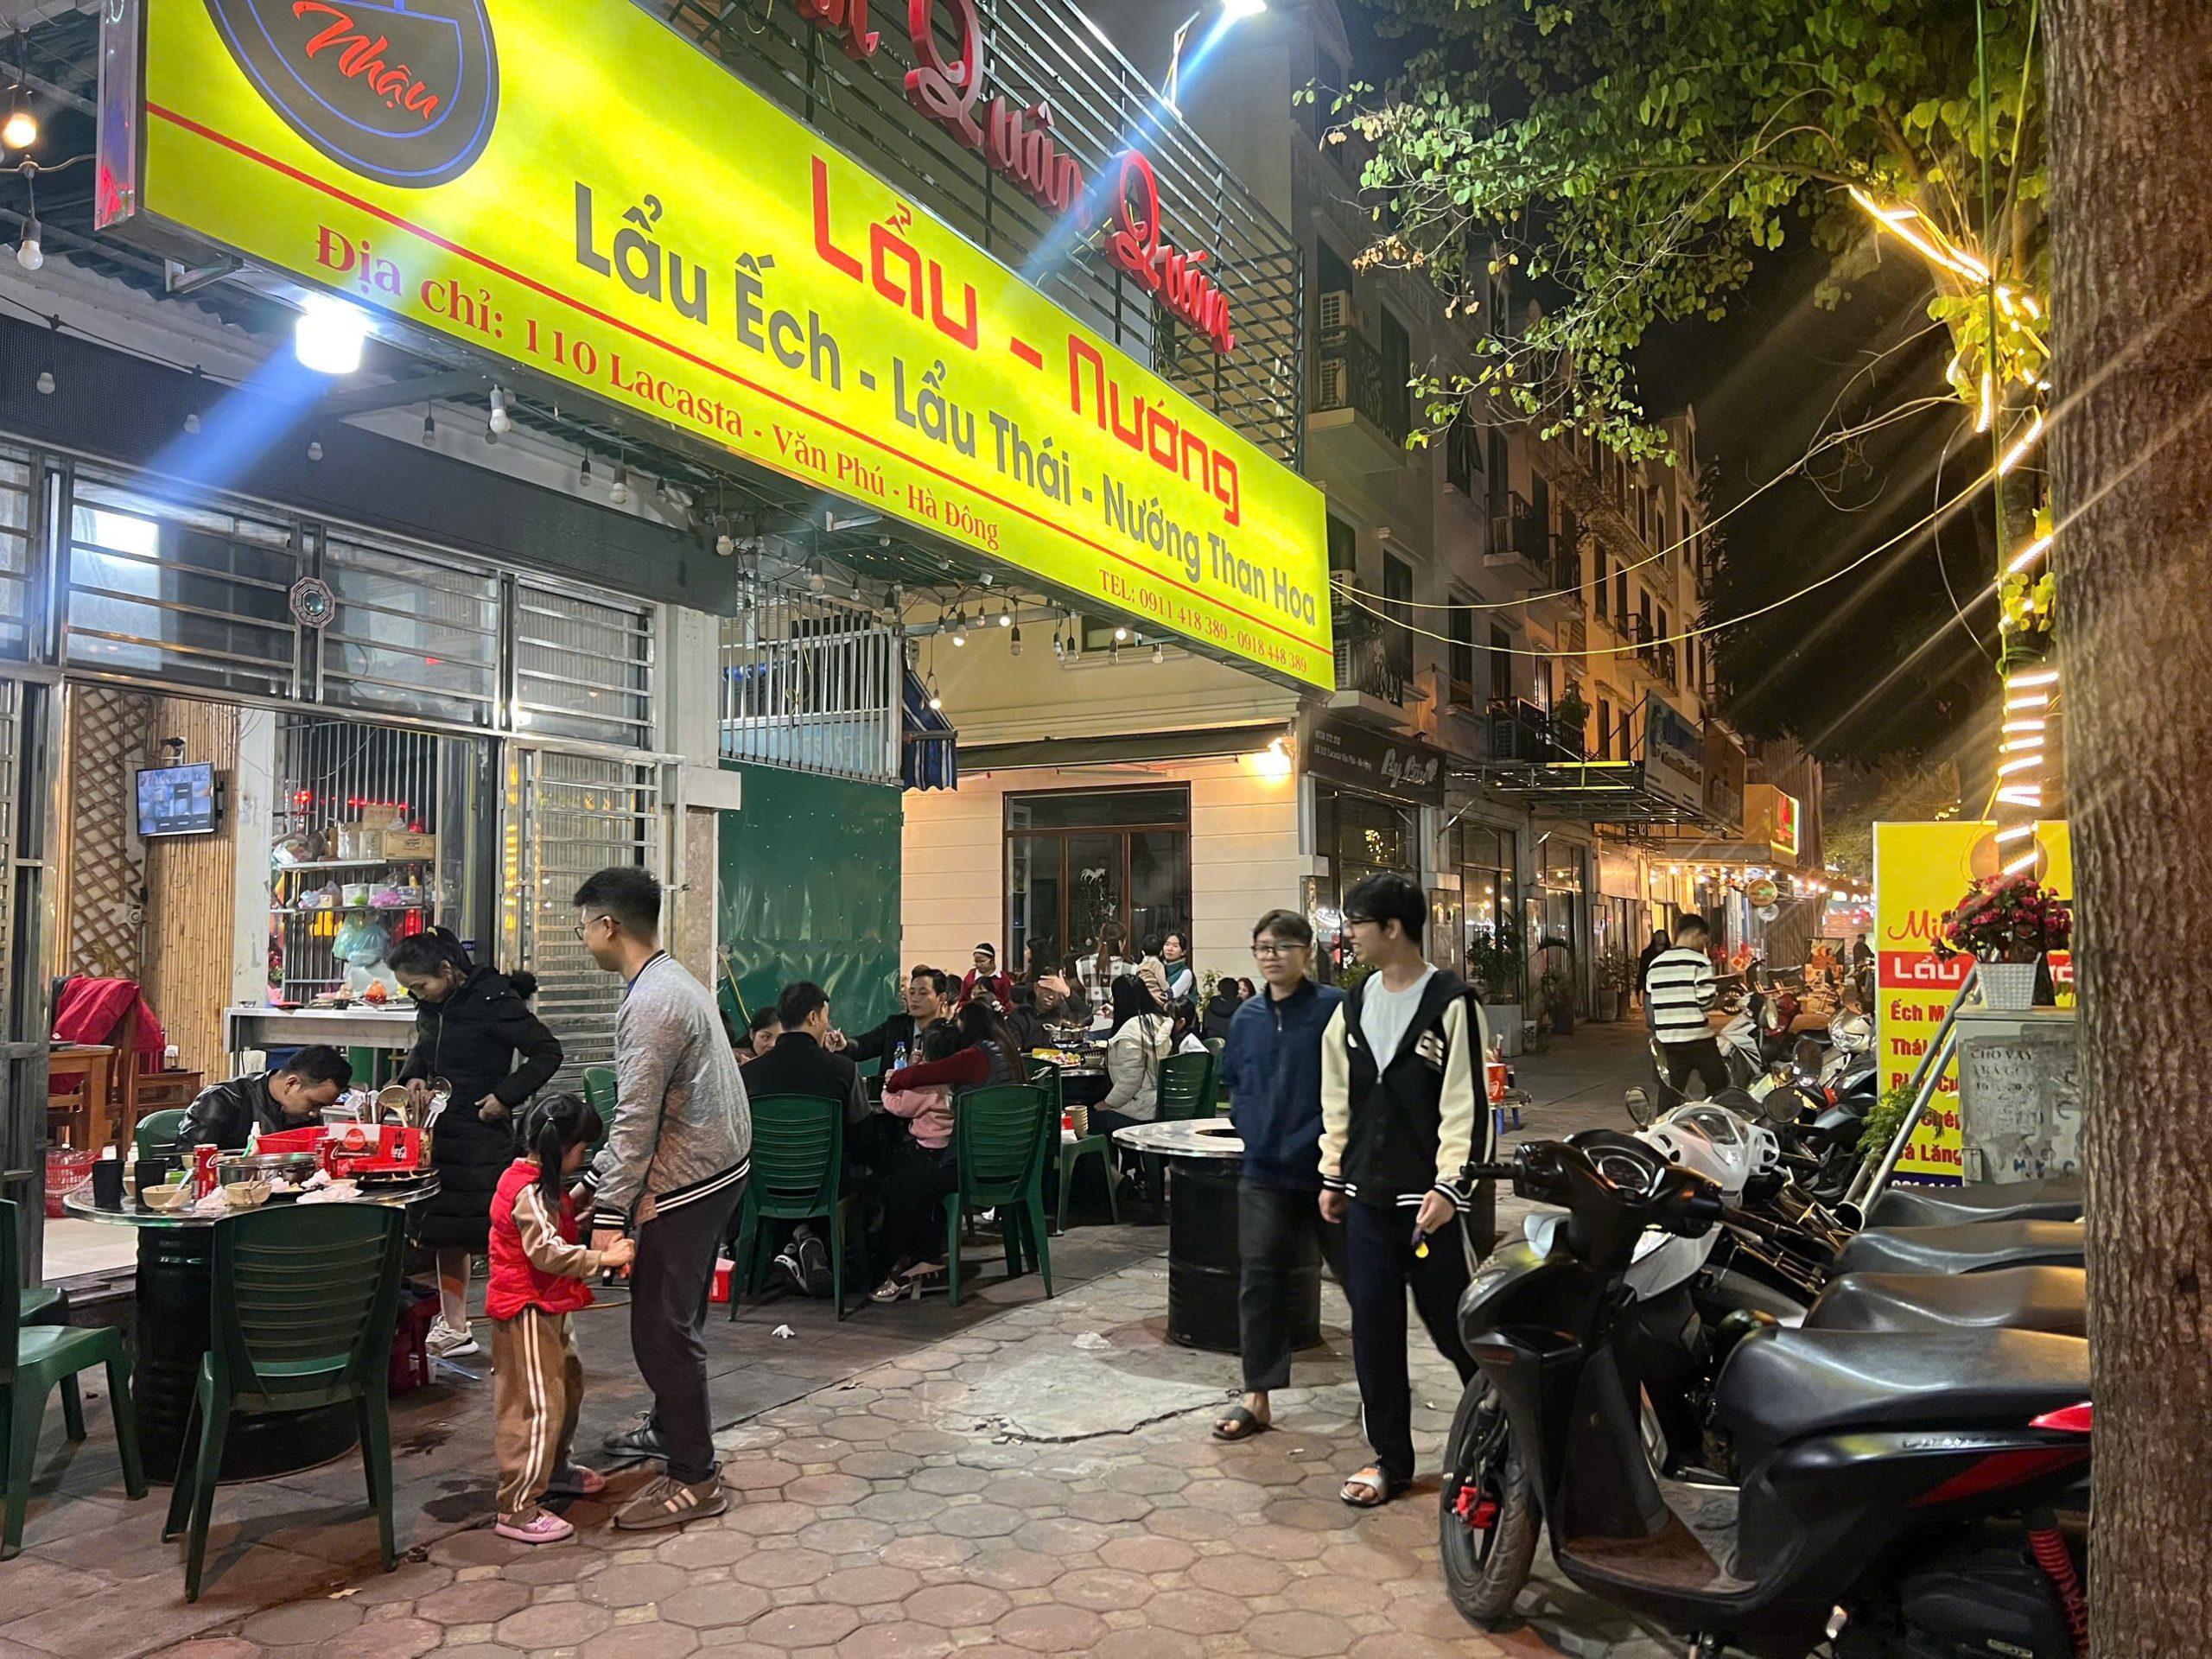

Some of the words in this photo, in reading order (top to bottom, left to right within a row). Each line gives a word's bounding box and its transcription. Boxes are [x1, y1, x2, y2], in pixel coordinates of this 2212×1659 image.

[1106, 148, 1235, 353] Quán
[315, 224, 403, 296] Địa
[420, 278, 505, 339] chỉ:
[525, 318, 598, 377] 110
[609, 353, 744, 439] Lacasta
[771, 423, 828, 474] Văn
[836, 452, 886, 499] Phú
[907, 483, 938, 521] Hà
[944, 499, 1000, 551] Đông
[575, 180, 708, 325] Lẩu
[735, 251, 841, 391] Ếch
[893, 359, 976, 459] Lẩu
[988, 410, 1071, 505] Thái
[1103, 474, 1201, 583] Nướng
[1207, 531, 1267, 603] Than
[1273, 566, 1316, 627] Hoa
[1068, 334, 1240, 526] Nướng
[1098, 569, 1136, 603] TEL:
[1139, 587, 1173, 621] 0911
[1178, 602, 1203, 632] 418
[1205, 614, 1229, 643] 389
[1236, 628, 1265, 658] 0918
[1267, 642, 1287, 666] 448
[1288, 652, 1307, 675] 389
[1891, 999, 1923, 1021] Ếch
